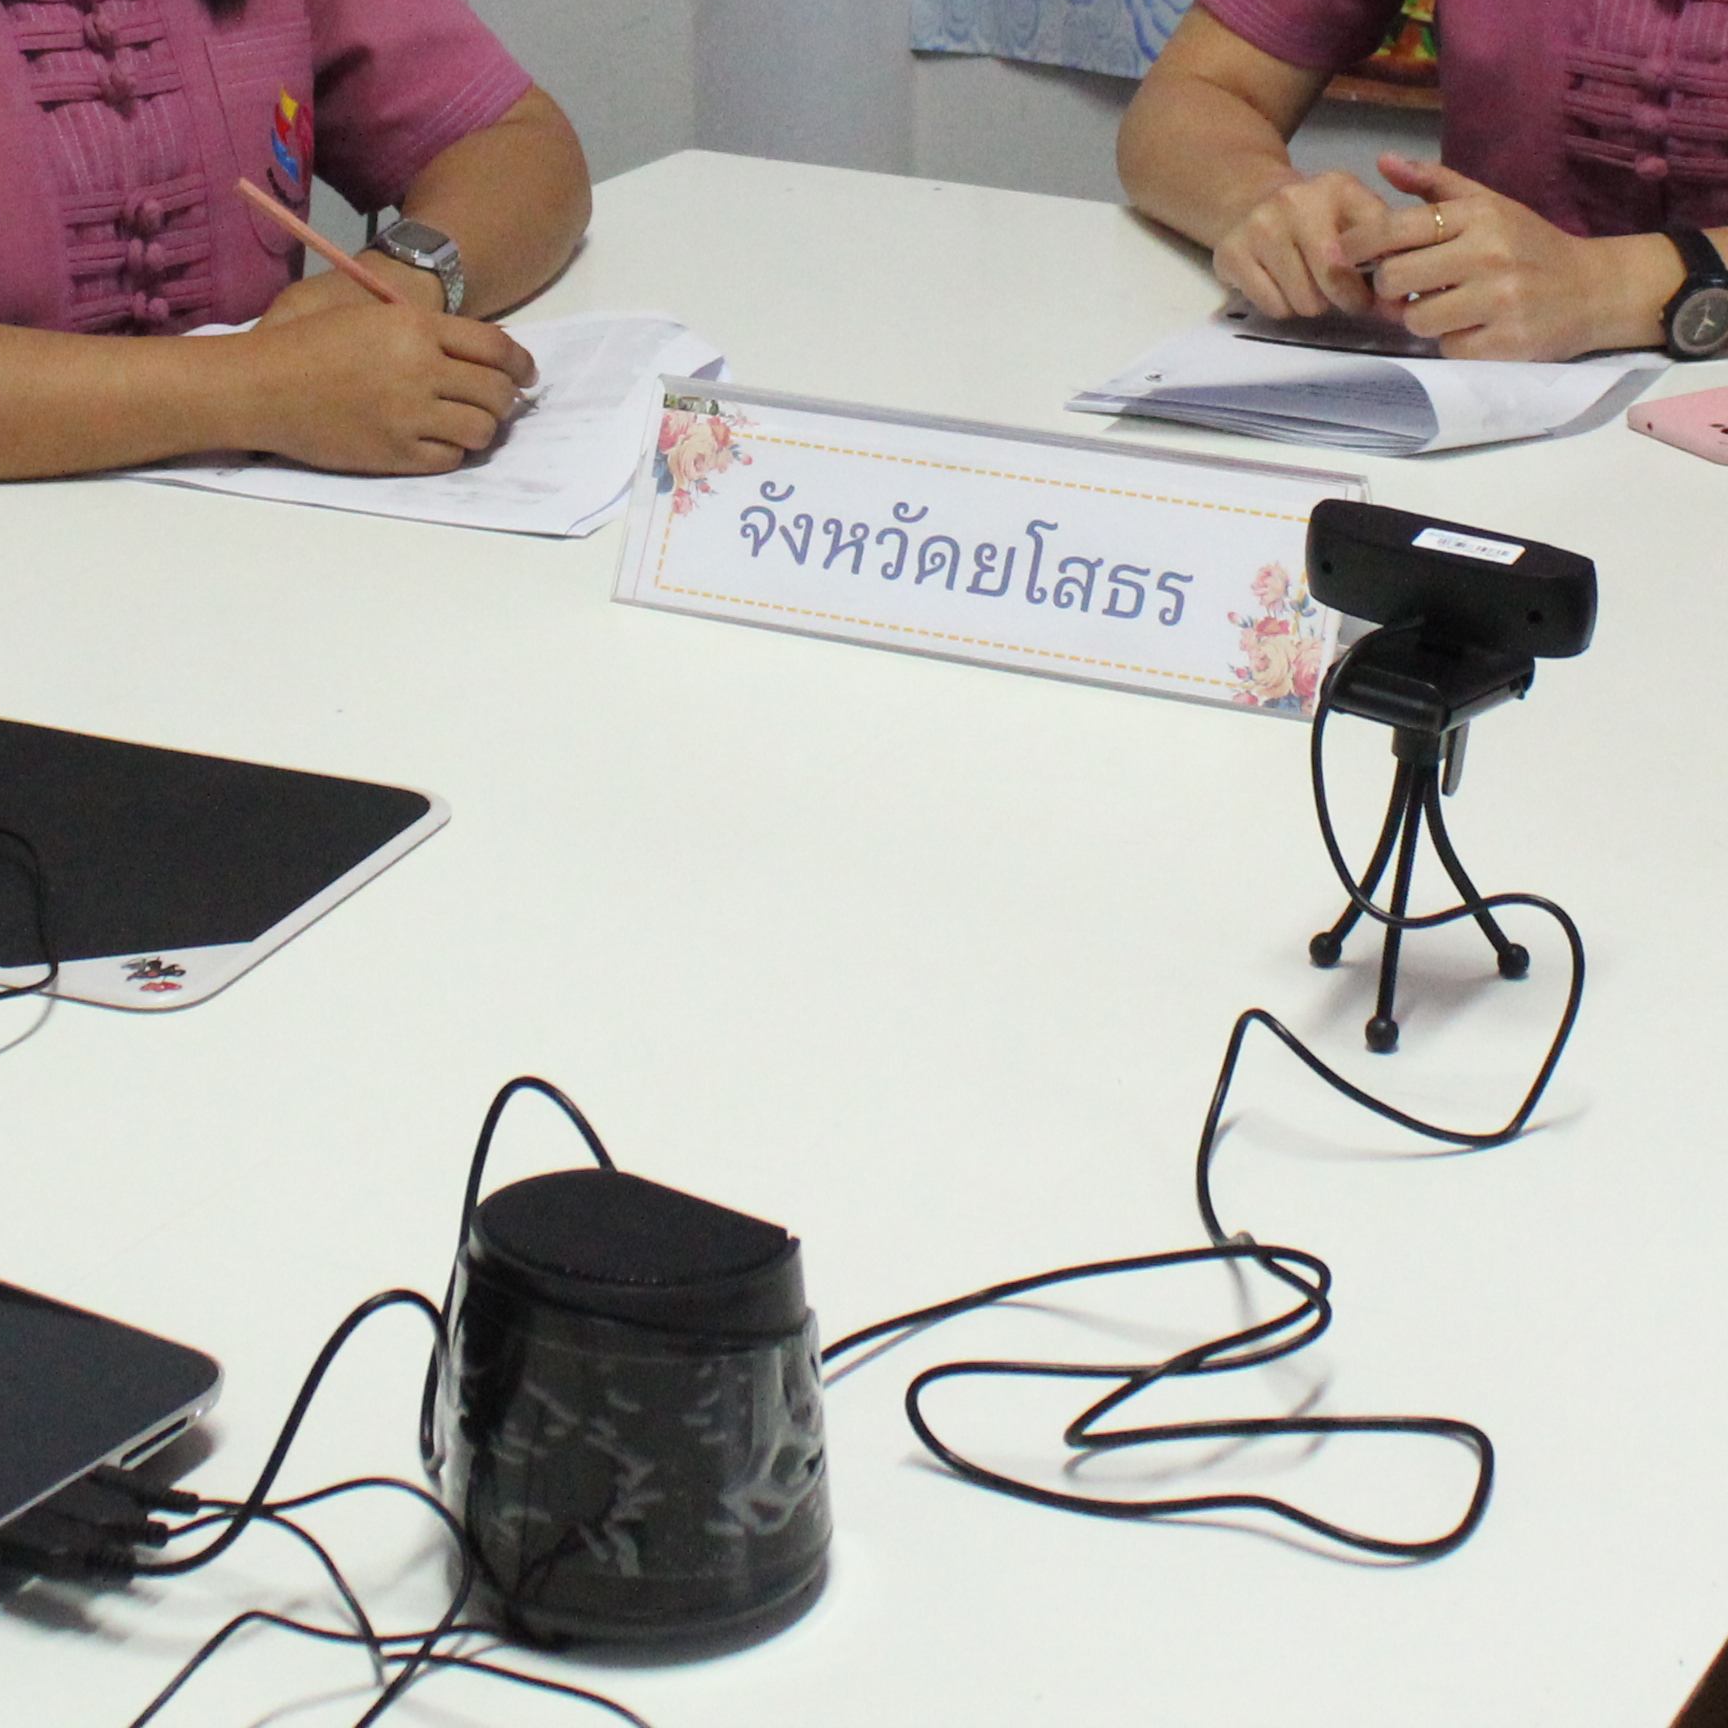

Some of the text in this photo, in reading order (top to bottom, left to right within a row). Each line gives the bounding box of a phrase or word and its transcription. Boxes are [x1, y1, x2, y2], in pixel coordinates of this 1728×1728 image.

[738, 480, 1193, 630] จังหวัดยโสธร
